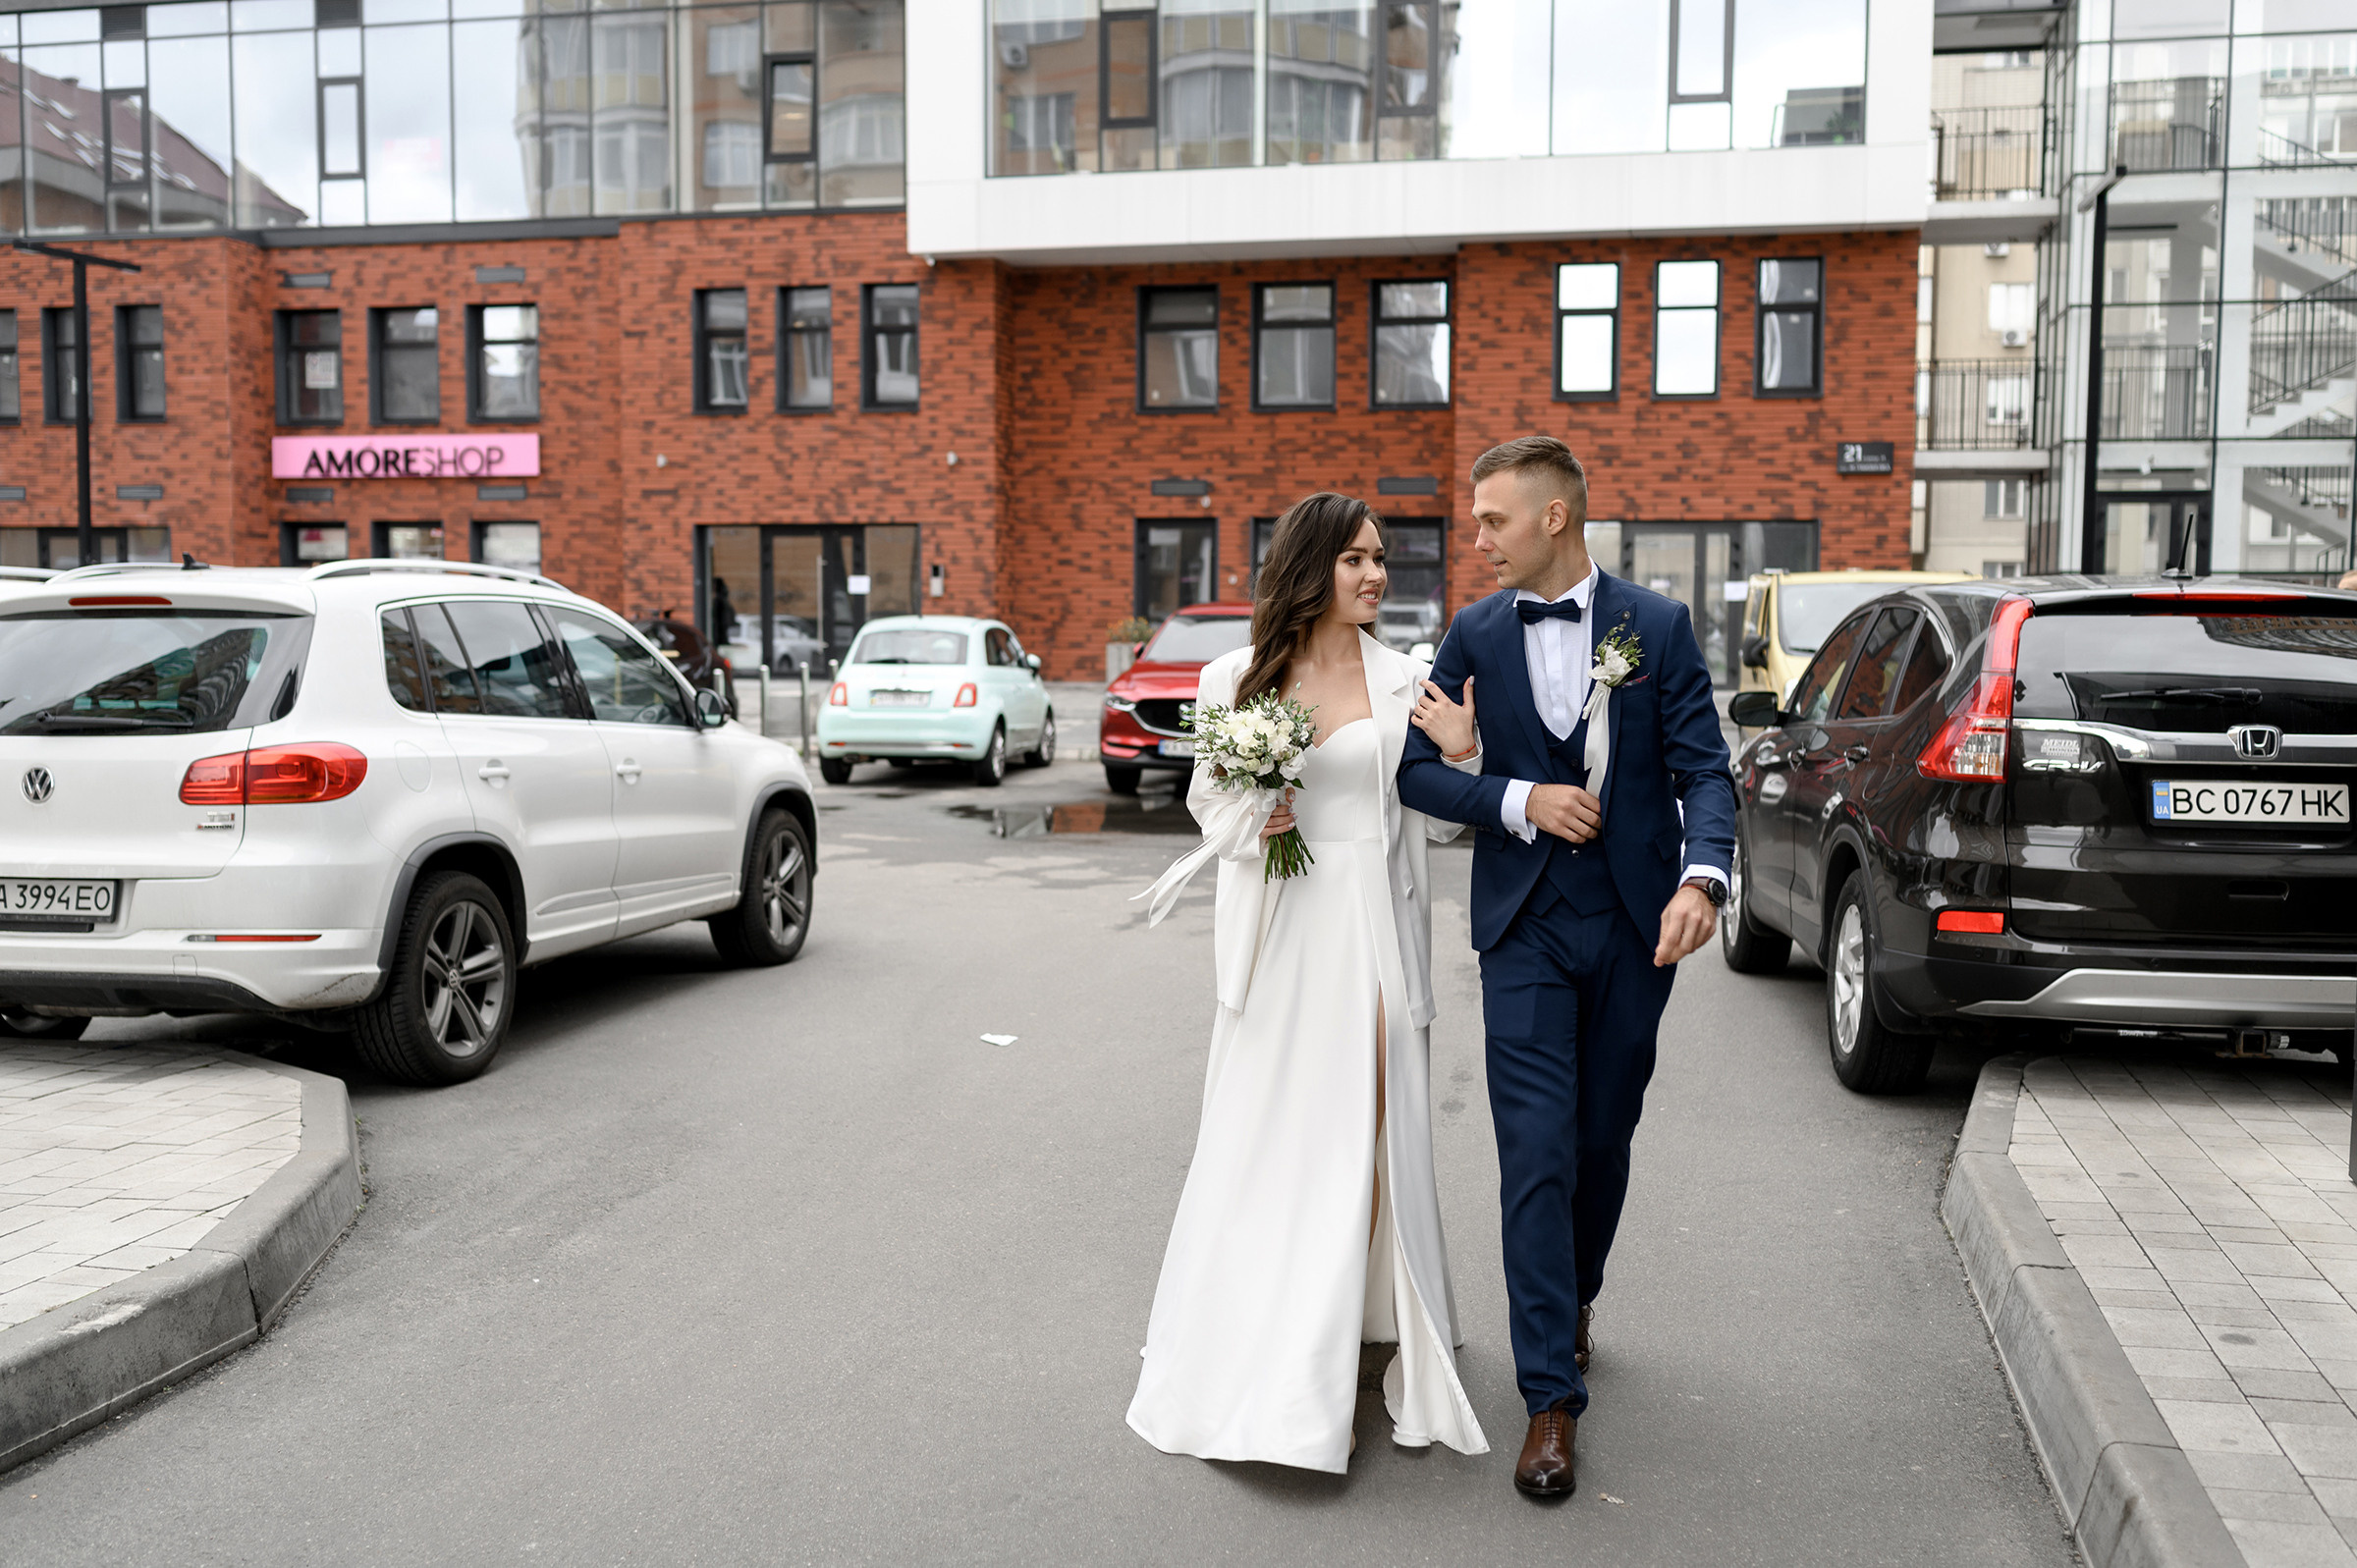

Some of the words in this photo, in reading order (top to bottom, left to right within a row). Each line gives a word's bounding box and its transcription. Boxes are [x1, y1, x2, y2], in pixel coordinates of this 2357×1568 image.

[1843, 444, 1863, 462] 21
[2023, 759, 2106, 773] CR-V
[2156, 805, 2169, 815] UA
[2172, 788, 2216, 814] BC
[2223, 788, 2293, 816] 0767
[2301, 789, 2344, 817] HK
